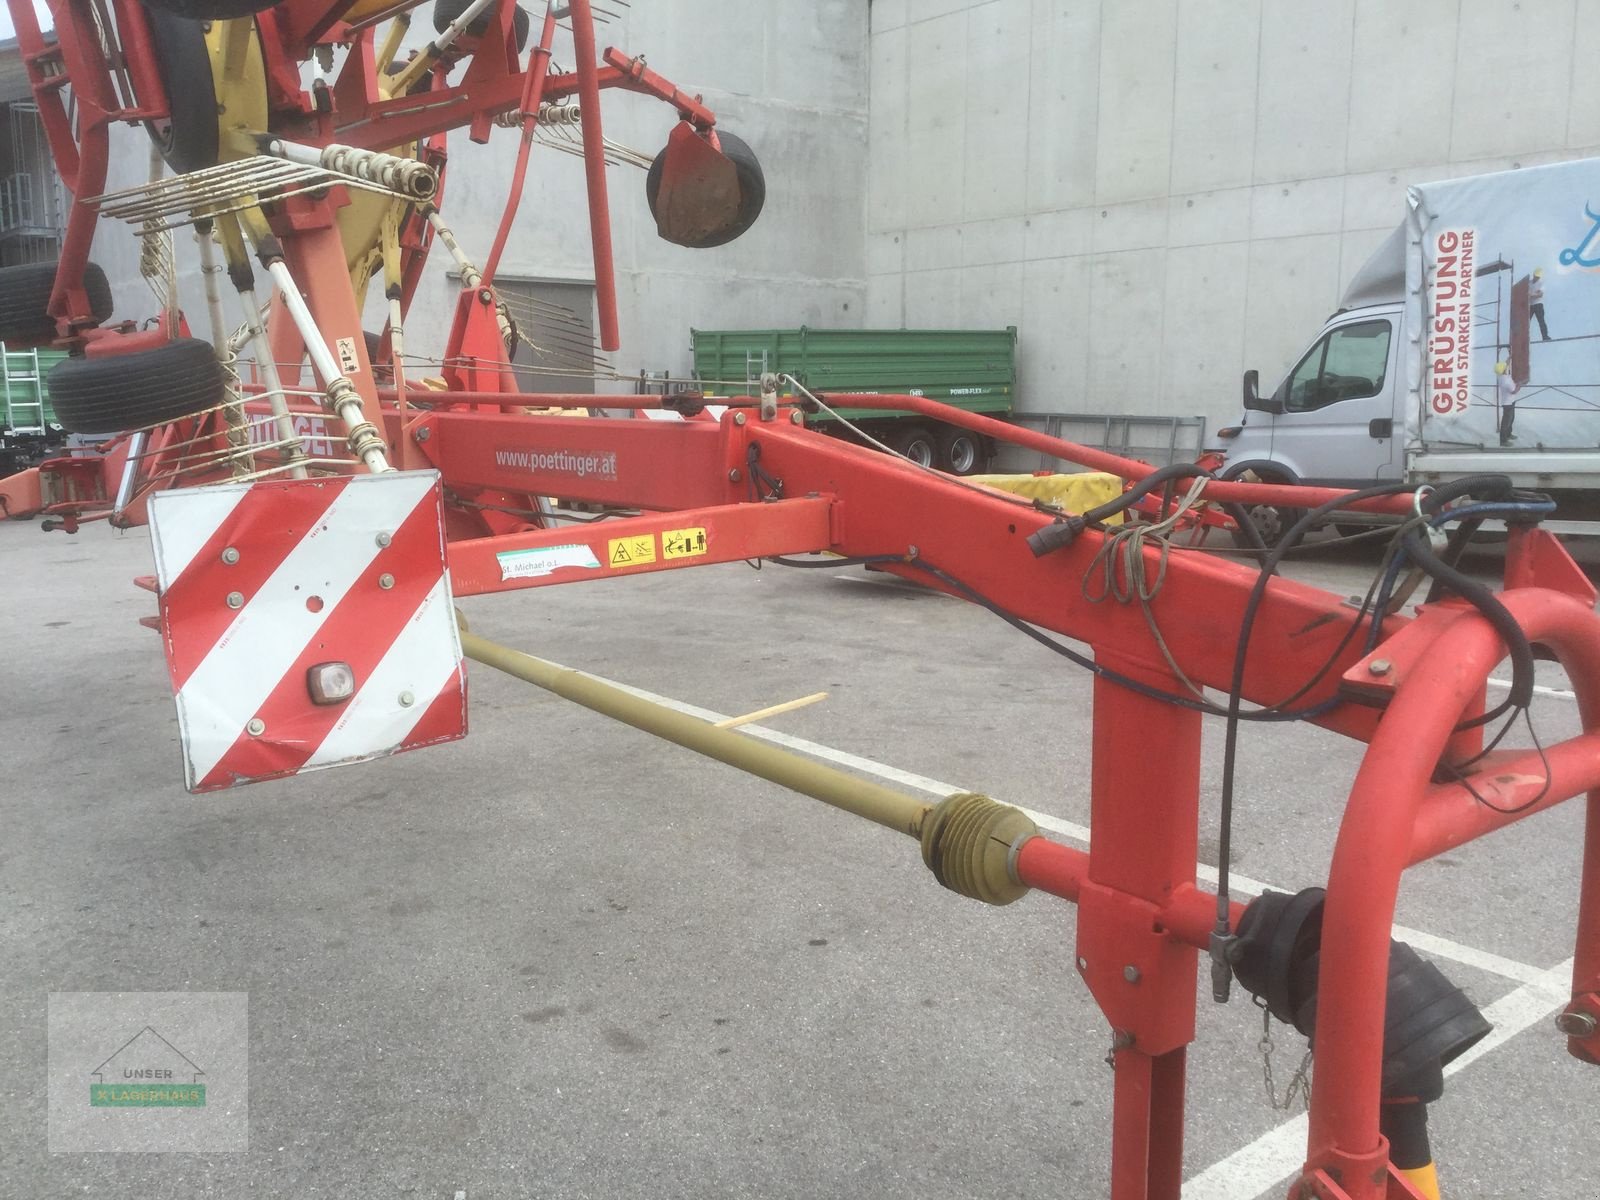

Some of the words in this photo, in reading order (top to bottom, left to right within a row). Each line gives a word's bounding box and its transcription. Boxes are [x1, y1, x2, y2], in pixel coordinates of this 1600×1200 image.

[1460, 230, 1473, 298] PARTNER
[1430, 231, 1458, 414] GERÜSTUNG
[1457, 303, 1470, 370] STARKEN
[1456, 375, 1468, 412] VOM
[496, 450, 615, 476] www.poettinger.at
[515, 560, 545, 572] Michael
